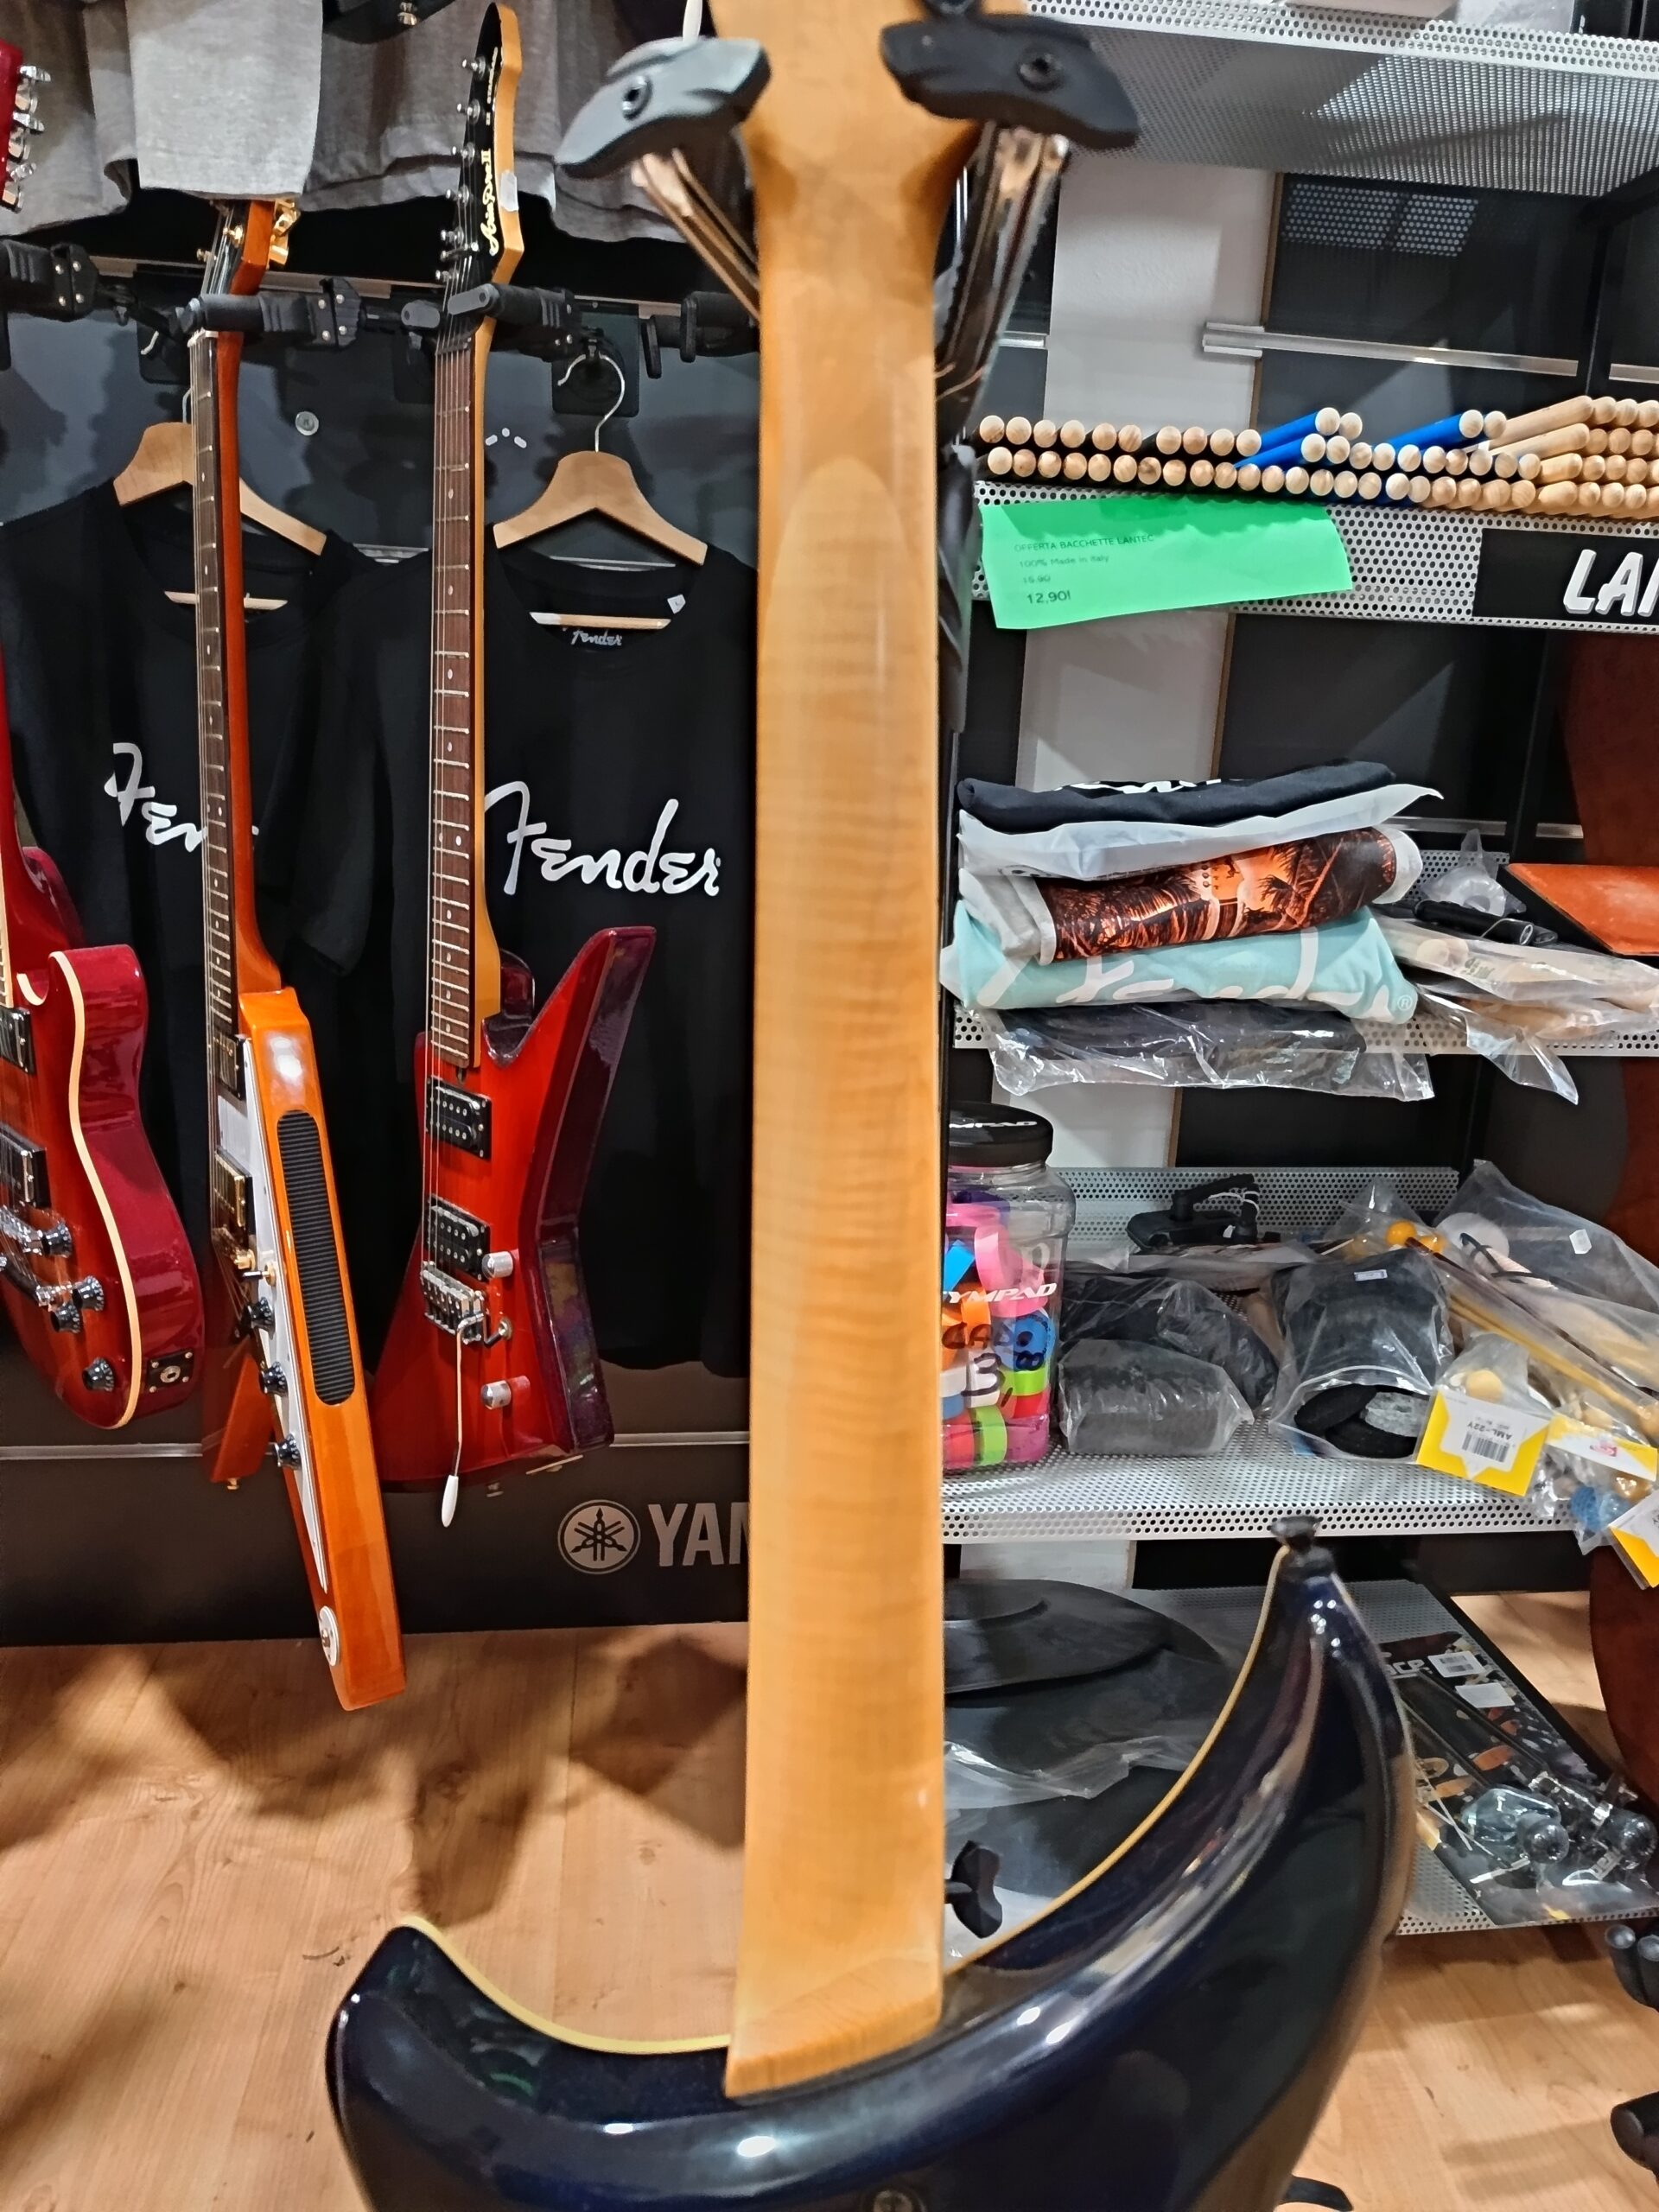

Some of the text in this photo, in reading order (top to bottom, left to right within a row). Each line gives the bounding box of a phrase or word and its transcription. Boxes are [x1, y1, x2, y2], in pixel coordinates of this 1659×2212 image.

[1014, 534, 1155, 552] OFFERTA BACCHETTE LANTEC
[1020, 558, 1048, 568] 100%
[1090, 554, 1109, 563] Italy
[104, 742, 259, 853] Fen
[485, 780, 720, 896] Fender
[943, 1282, 1058, 1304] YMPAD
